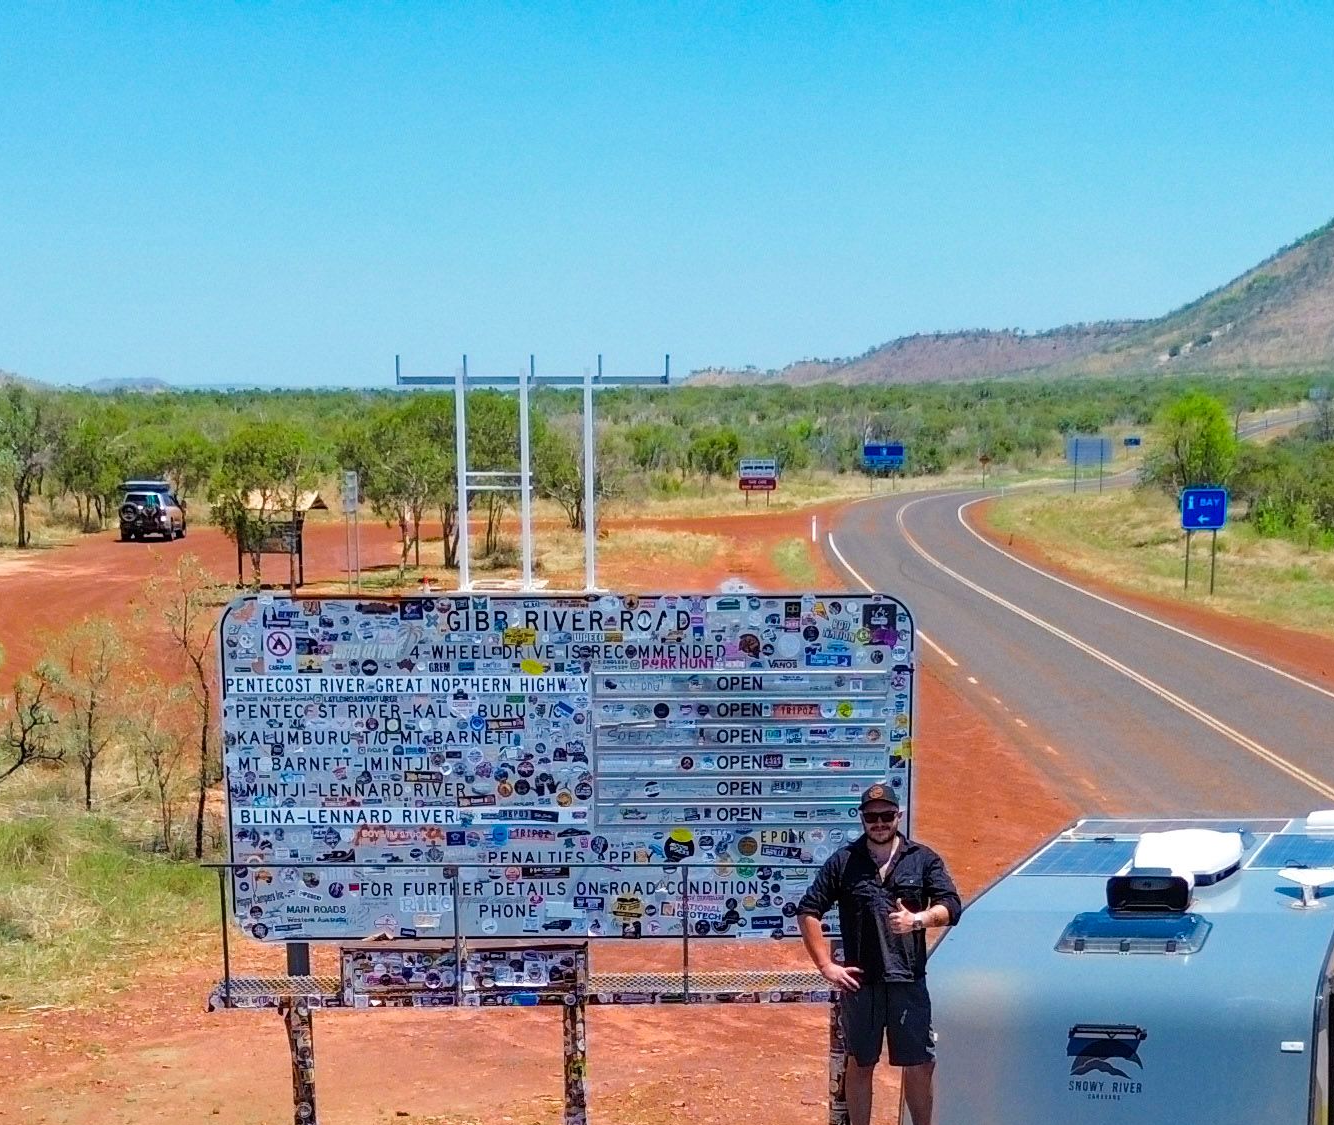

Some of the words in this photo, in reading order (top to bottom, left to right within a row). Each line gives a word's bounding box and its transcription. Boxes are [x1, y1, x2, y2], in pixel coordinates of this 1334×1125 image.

[446, 610, 509, 632] GIBB
[525, 610, 603, 632] RIVER
[409, 645, 420, 660] 4
[431, 644, 492, 660] WHEEL
[502, 644, 555, 660] DRIVE
[591, 644, 726, 660] RECMMENDED
[226, 677, 312, 693] PENTECOST
[520, 677, 588, 693] HIGHWY
[717, 676, 763, 691] OPEN
[717, 702, 763, 717] OPEN
[237, 730, 351, 745] KALUMBURU
[433, 730, 514, 745] BARNETT
[717, 728, 763, 744] OPEN
[238, 757, 261, 771] MT
[717, 755, 763, 770] OPEN
[413, 782, 466, 797] RIVER
[717, 781, 762, 796] OPEN
[402, 809, 455, 824] RIVER
[717, 807, 763, 822] OPEN
[360, 882, 394, 897] FOR
[403, 882, 484, 896] FURTHER
[494, 881, 566, 896] DETAILS
[576, 881, 599, 896] ON
[609, 881, 657, 896] ROAD
[667, 880, 770, 895] CONDITIONS
[286, 905, 310, 914] MAIN
[313, 905, 347, 914] ROADS
[479, 904, 538, 918] PHONE
[677, 910, 722, 920] GOTECH
[1068, 1080, 1105, 1092] SNOWY
[1112, 1082, 1143, 1094] RIVER
